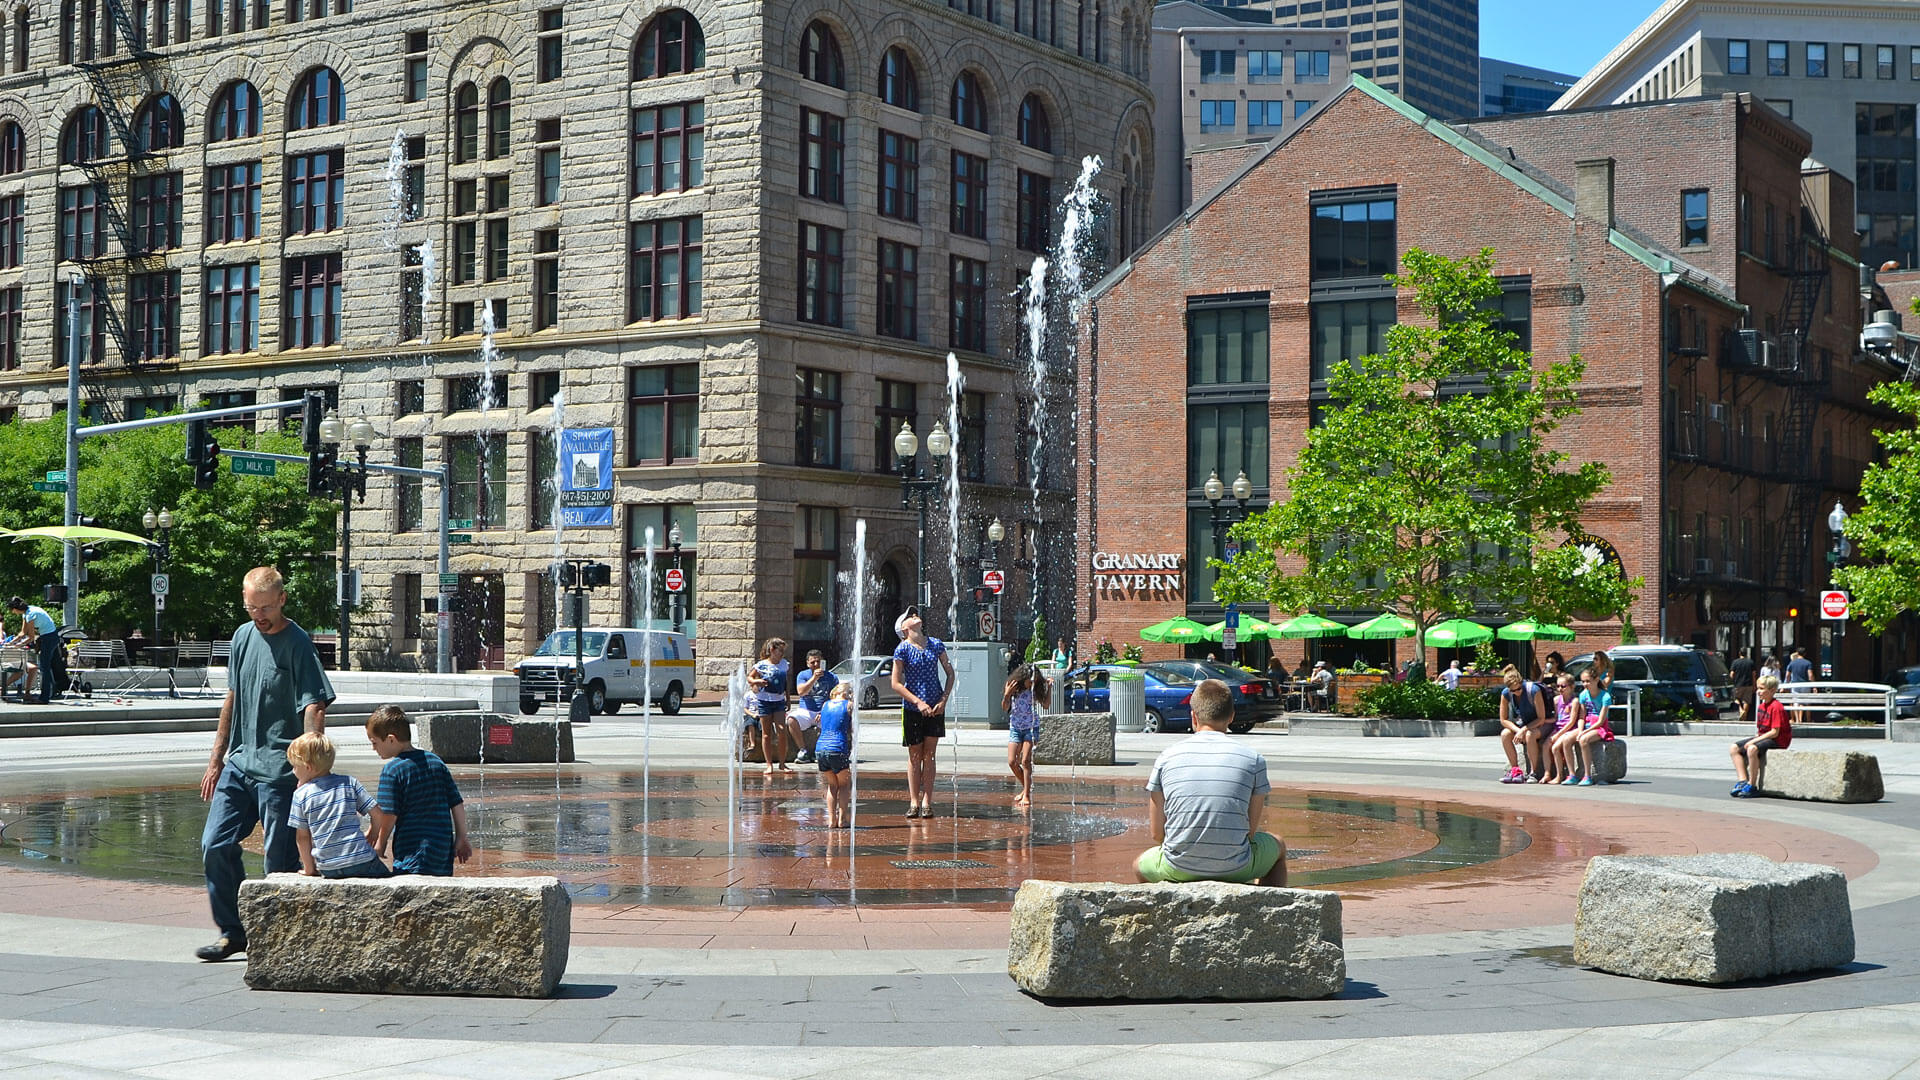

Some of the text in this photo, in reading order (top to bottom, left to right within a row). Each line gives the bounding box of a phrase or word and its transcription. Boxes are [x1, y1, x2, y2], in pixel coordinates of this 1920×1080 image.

[572, 431, 600, 441] SPACE
[562, 441, 610, 452] AVAILABLE
[246, 461, 263, 471] MILK
[564, 511, 585, 524] BEAL
[1579, 534, 1611, 550] STREET
[1092, 551, 1181, 570] GRANARY
[1094, 574, 1180, 590] TAVERN
